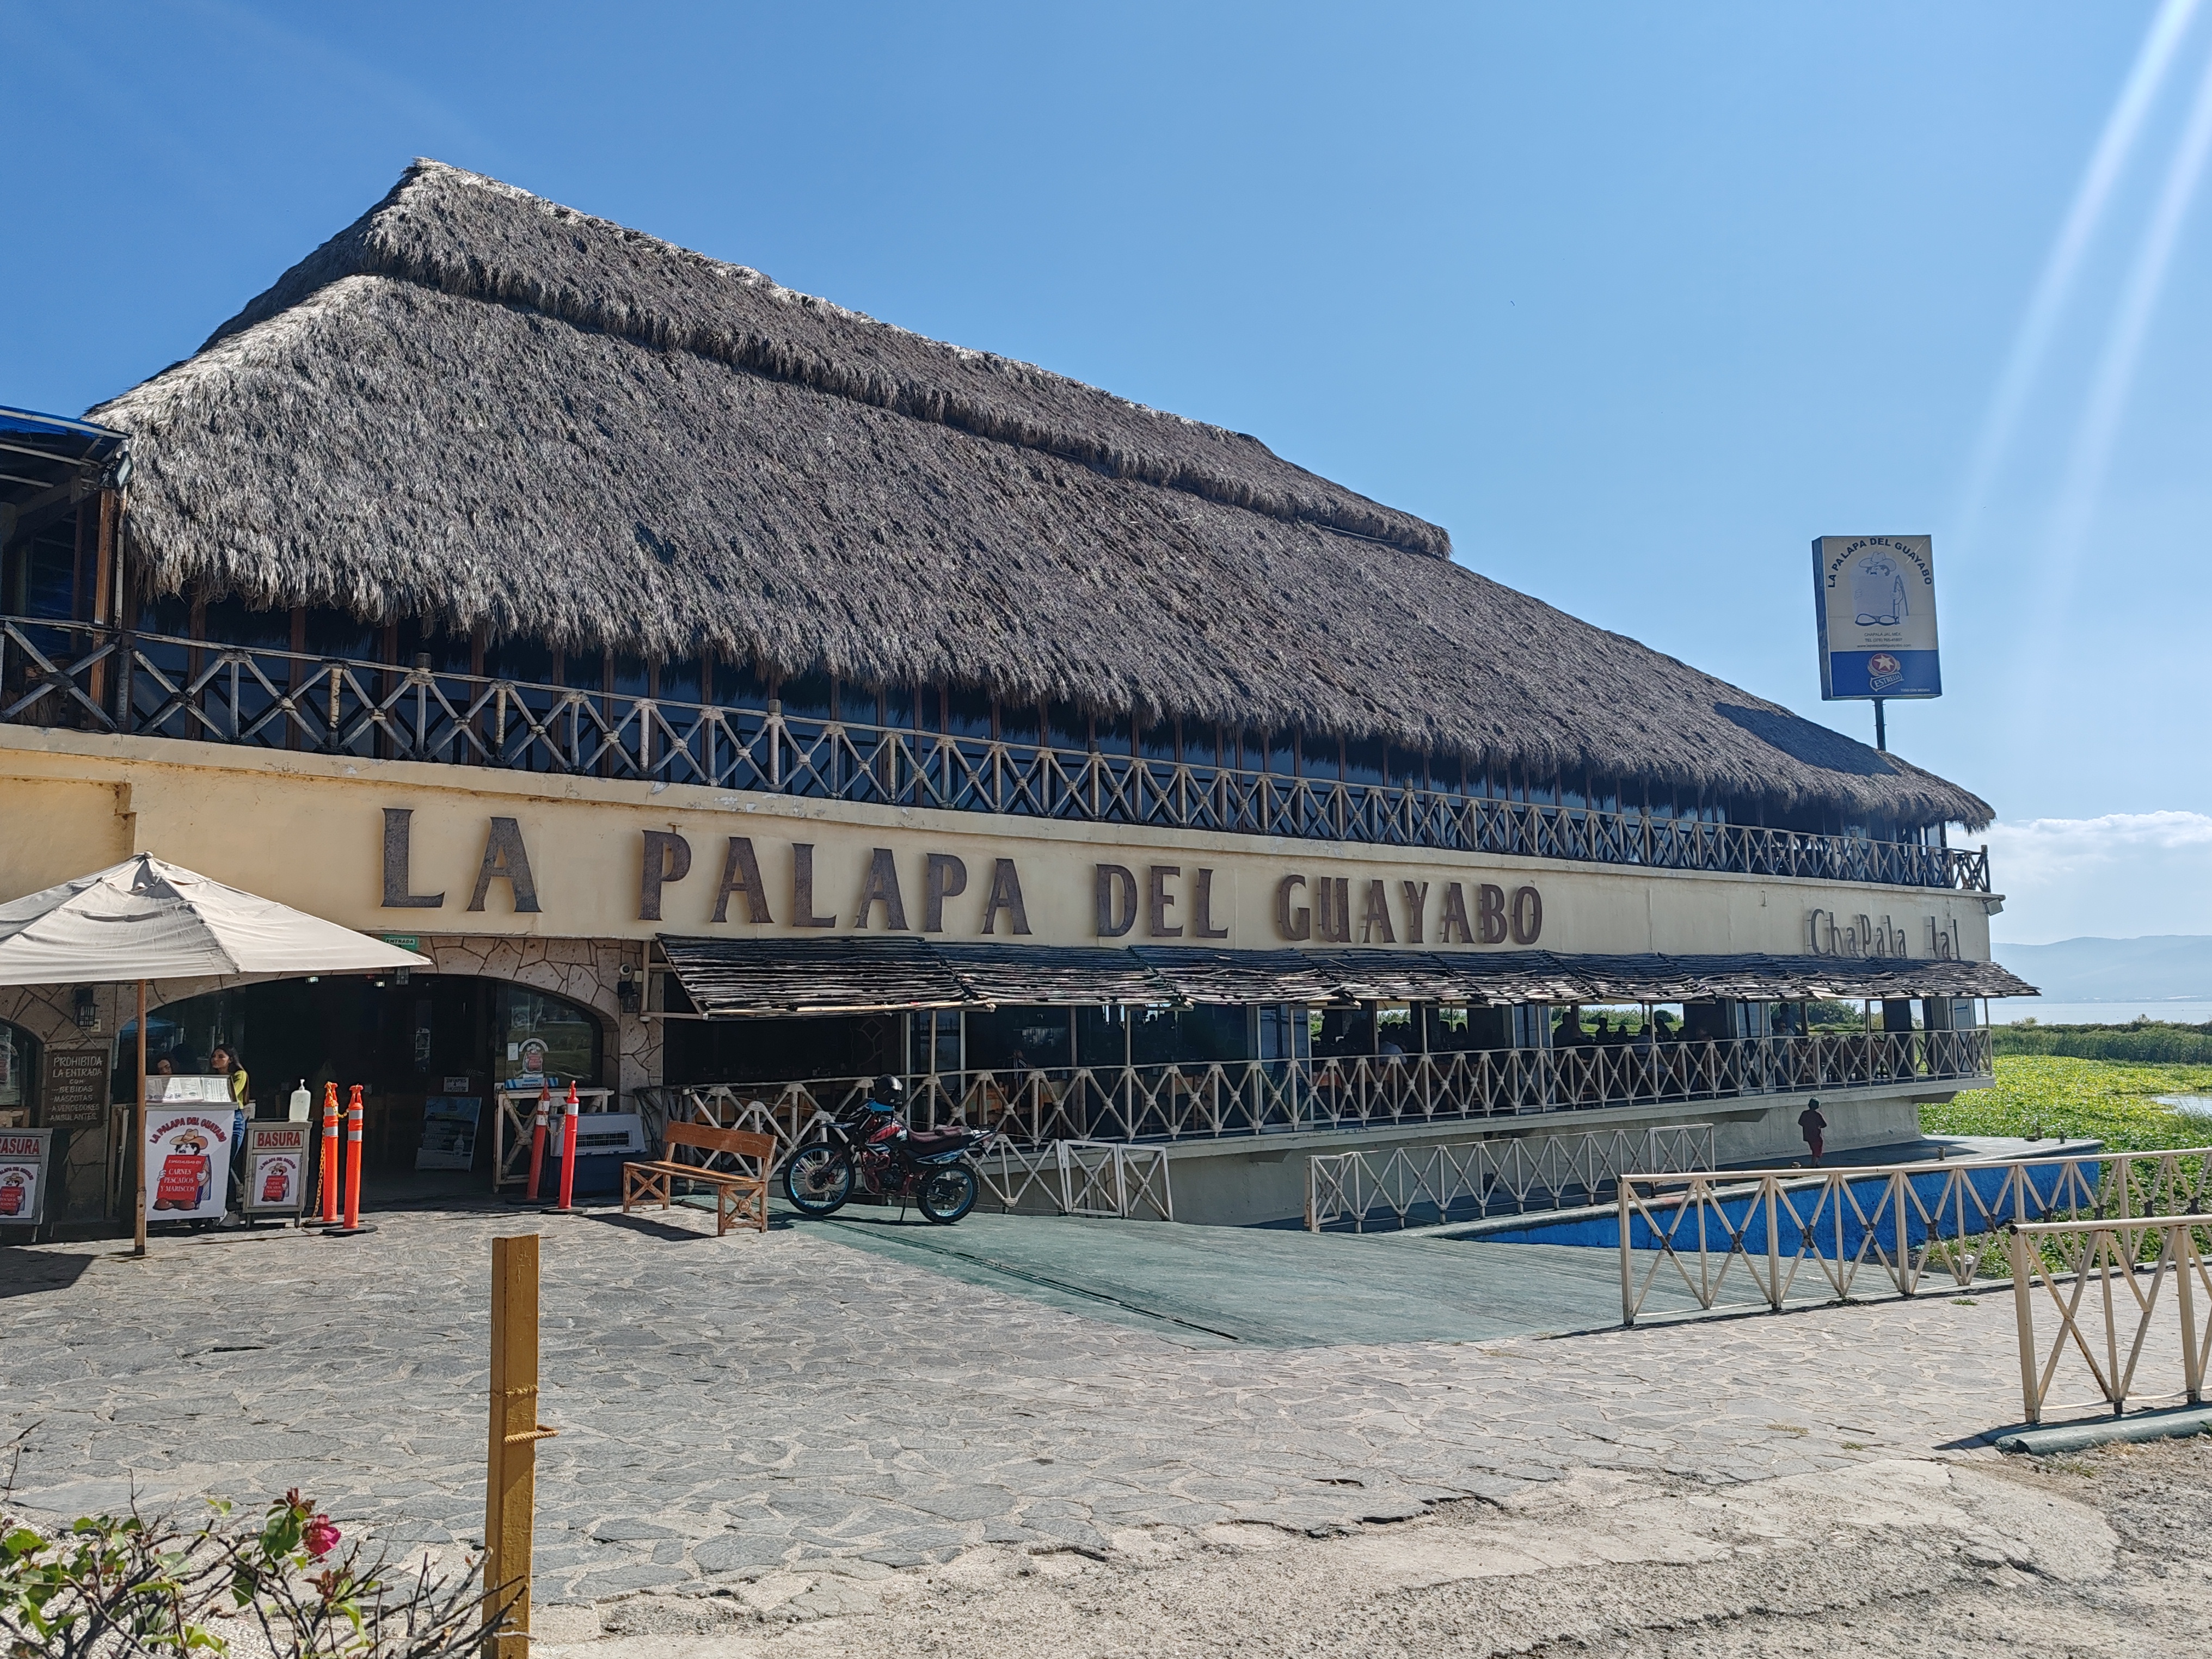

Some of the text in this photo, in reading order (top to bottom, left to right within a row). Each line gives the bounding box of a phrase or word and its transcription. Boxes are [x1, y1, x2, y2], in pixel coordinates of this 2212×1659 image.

[1828, 538, 1932, 587] LA PALAPA DEL GUAYABO
[1874, 674, 1901, 687] ESTRELLA
[381, 808, 1543, 945] LA PALAPA DEL GUAYABO
[53, 1056, 103, 1067] PROHIBIDA
[52, 1068, 103, 1078] LA ENTRADA
[149, 1134, 161, 1144] LA
[156, 1118, 186, 1136] PALAPA
[187, 1117, 199, 1126] DEL
[257, 1132, 300, 1147] BASURA
